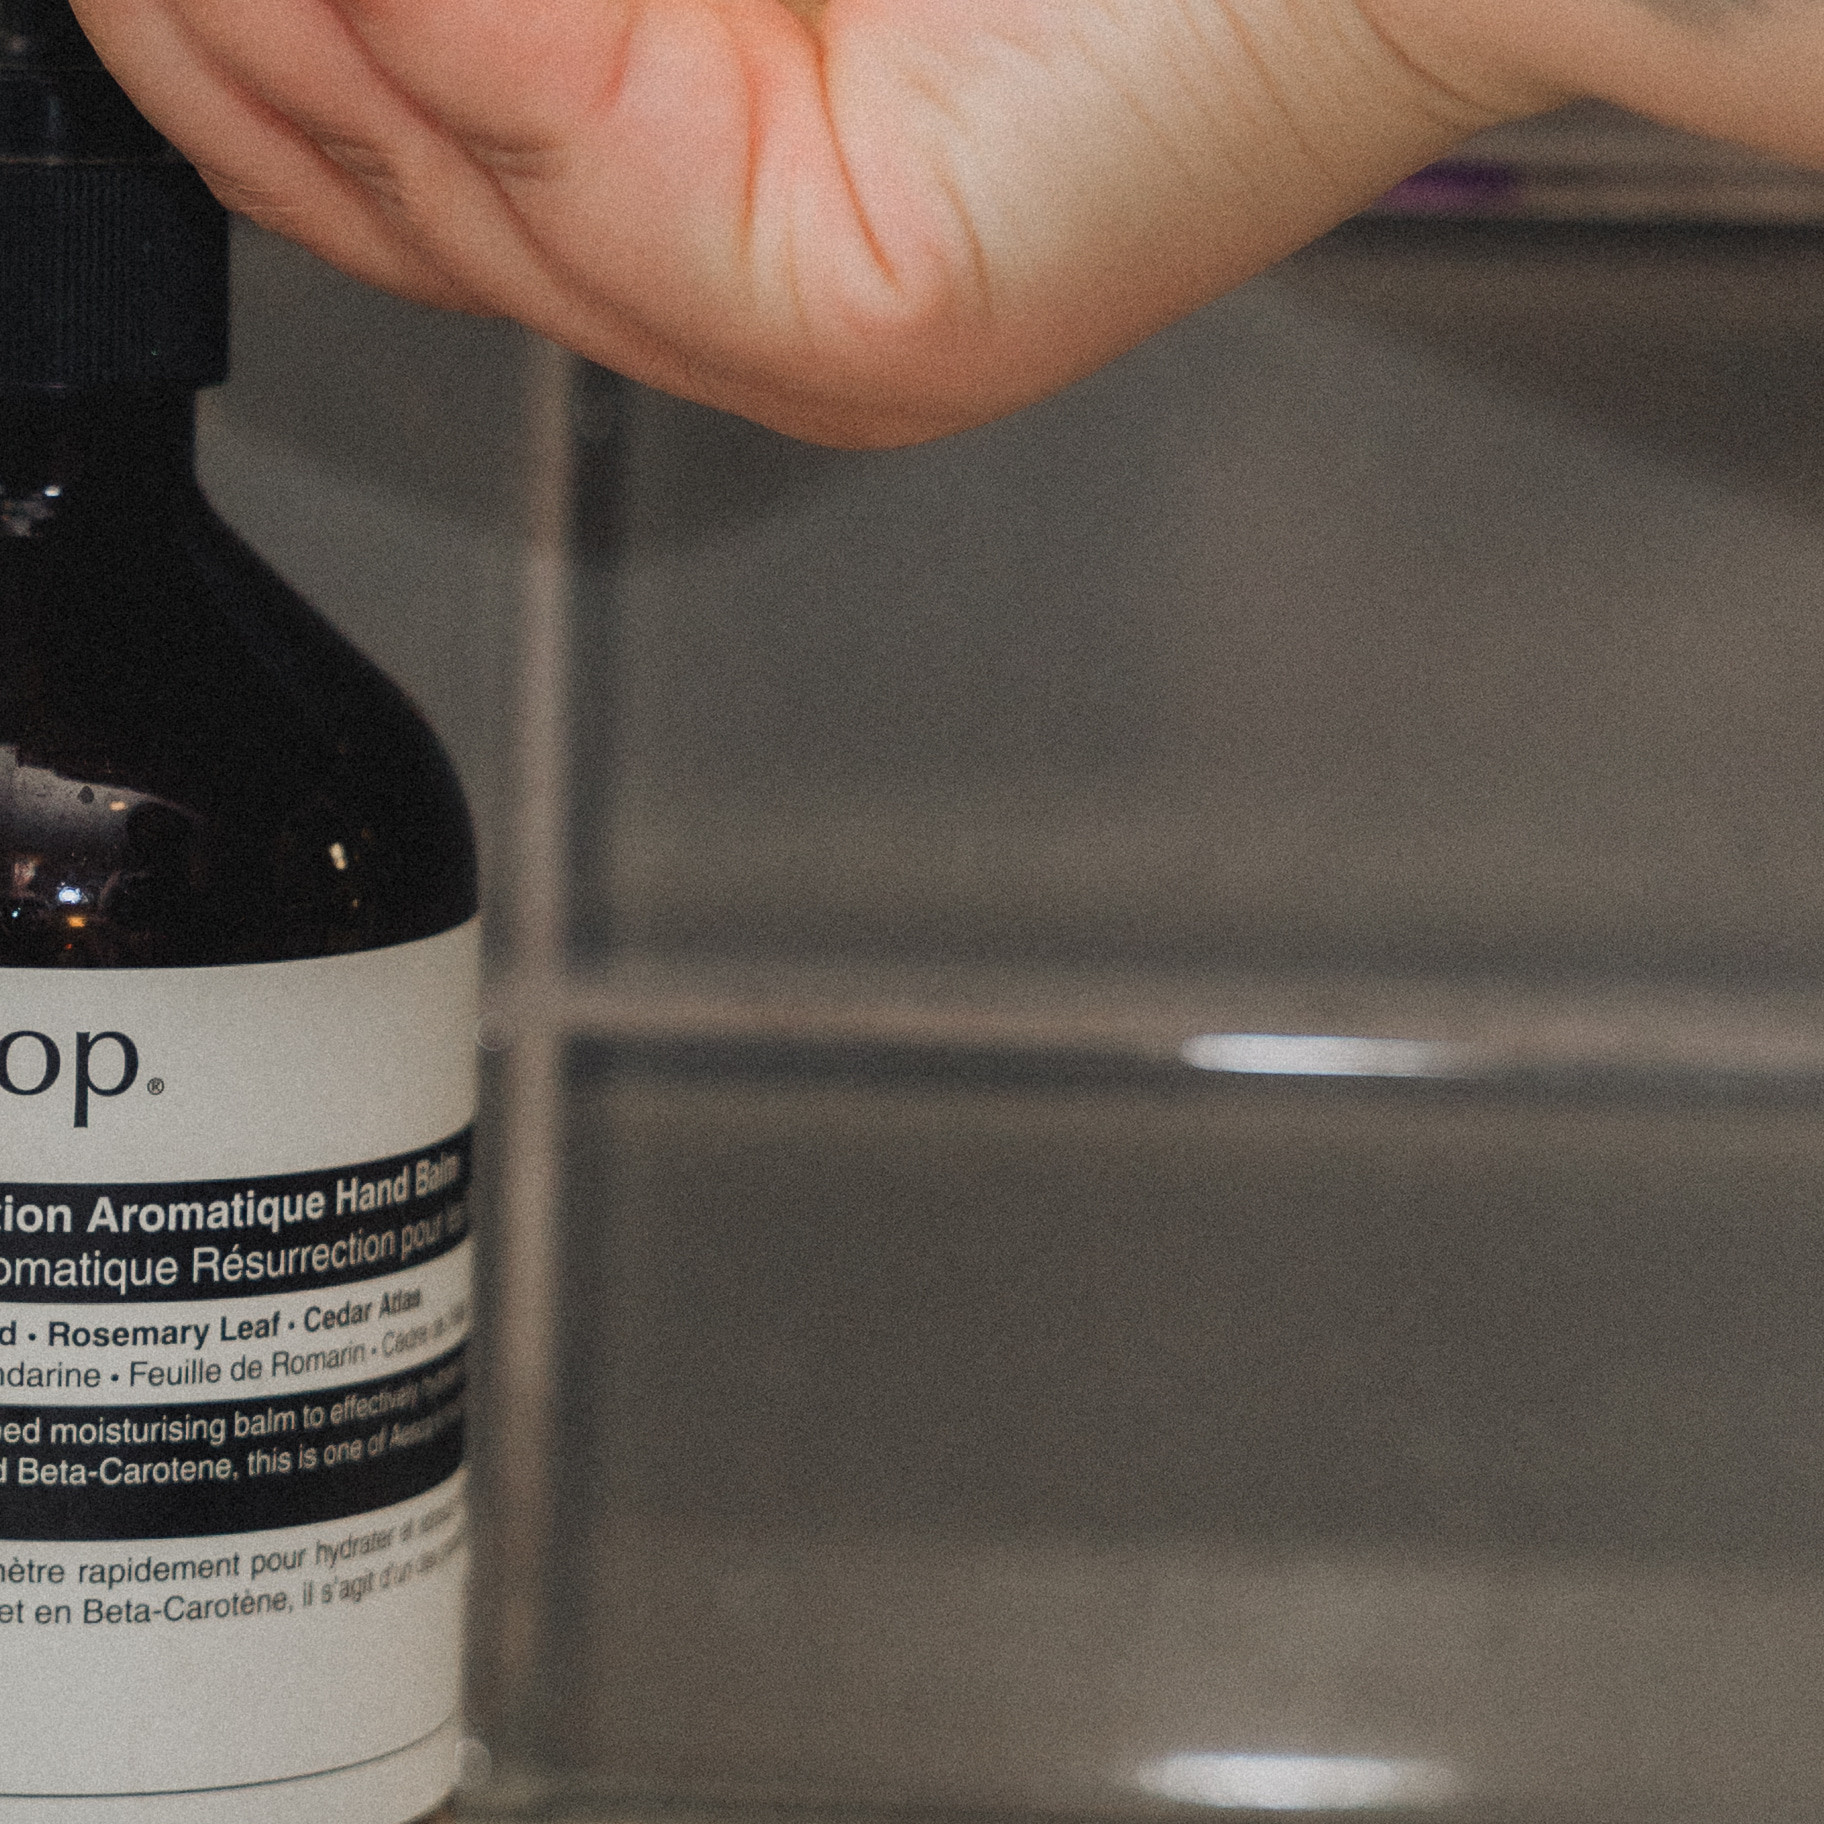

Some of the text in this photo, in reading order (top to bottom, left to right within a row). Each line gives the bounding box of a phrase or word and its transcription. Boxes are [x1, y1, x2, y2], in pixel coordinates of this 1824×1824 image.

[86, 1189, 325, 1233] Aromatique
[336, 1165, 409, 1216] Hand
[192, 1227, 396, 1284] Résurrection
[48, 1320, 210, 1350] Rosemary
[220, 1311, 281, 1342] Leaf
[303, 1300, 373, 1333] Cedar
[129, 1358, 222, 1387] Feuille
[230, 1355, 263, 1382] de
[271, 1341, 366, 1378] Romarin
[50, 1414, 227, 1447] moisturising
[234, 1407, 297, 1438] balm
[303, 1404, 325, 1428] to
[18, 1457, 239, 1486] Beta-Carotene,
[247, 1447, 293, 1475] this
[298, 1443, 318, 1470] is
[323, 1438, 363, 1467] one
[78, 1552, 240, 1589] rapidement
[251, 1547, 307, 1581] pour
[34, 1602, 72, 1625] en
[83, 1589, 294, 1624] Beta-Carotène,
[303, 1580, 314, 1607] il
[321, 1568, 375, 1603] s'agit
